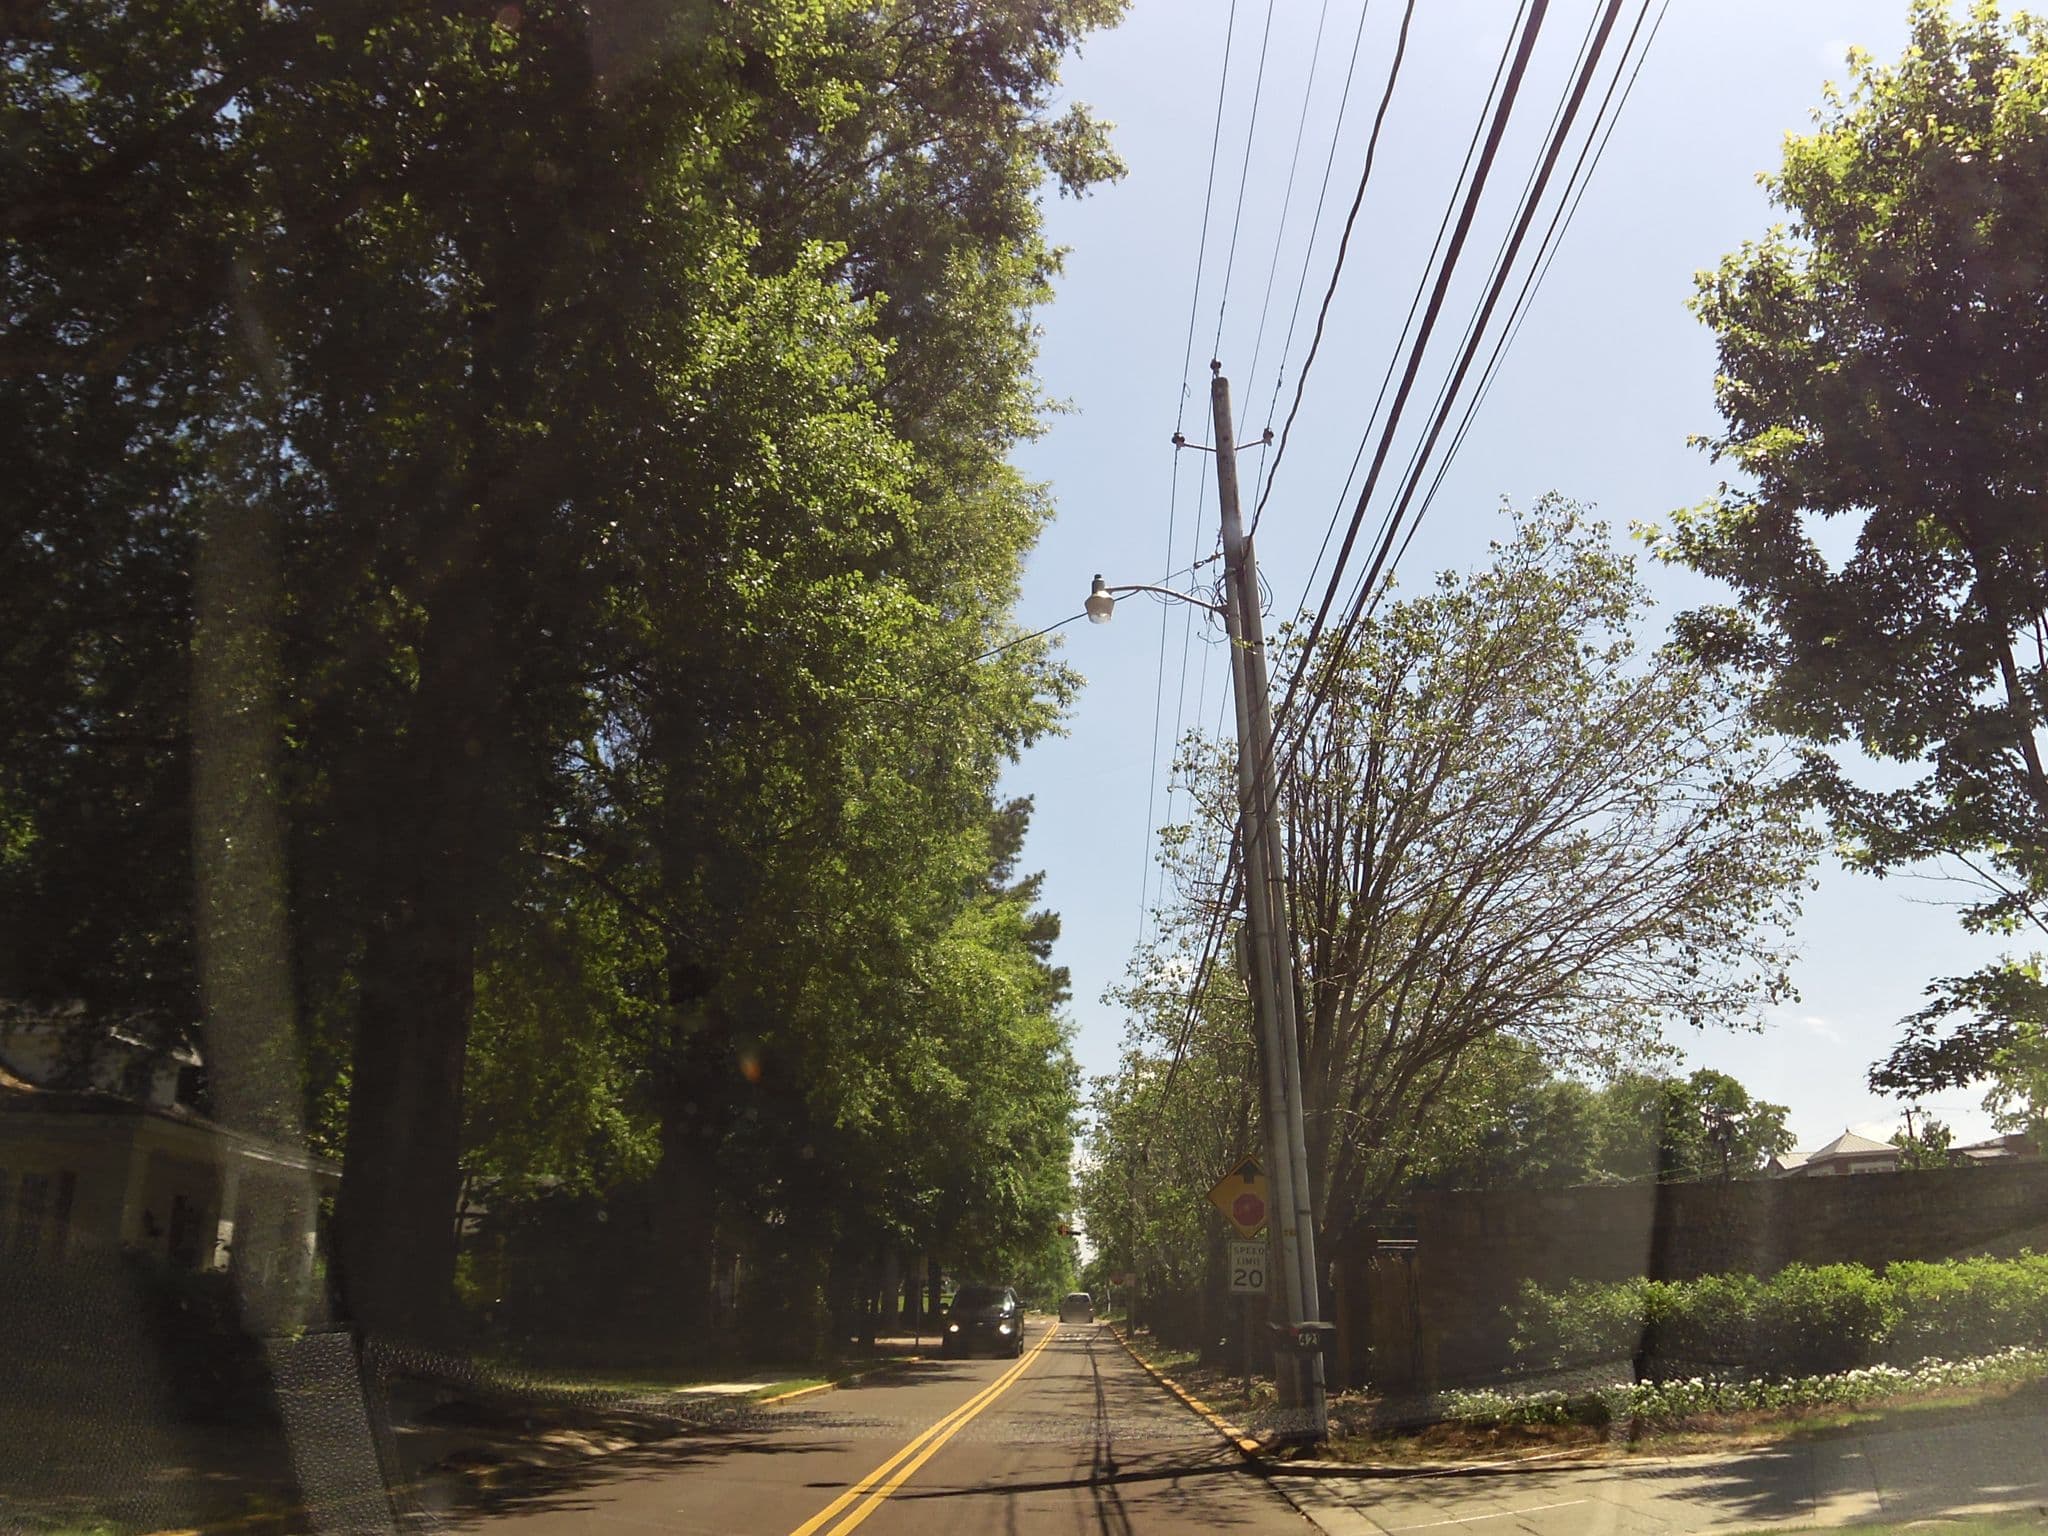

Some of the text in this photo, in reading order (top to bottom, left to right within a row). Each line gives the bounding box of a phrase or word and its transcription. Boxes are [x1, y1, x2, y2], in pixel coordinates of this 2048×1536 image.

[1233, 1247, 1265, 1255] SPEED
[1236, 1256, 1261, 1265] LIMIT
[1233, 1268, 1263, 1288] 20
